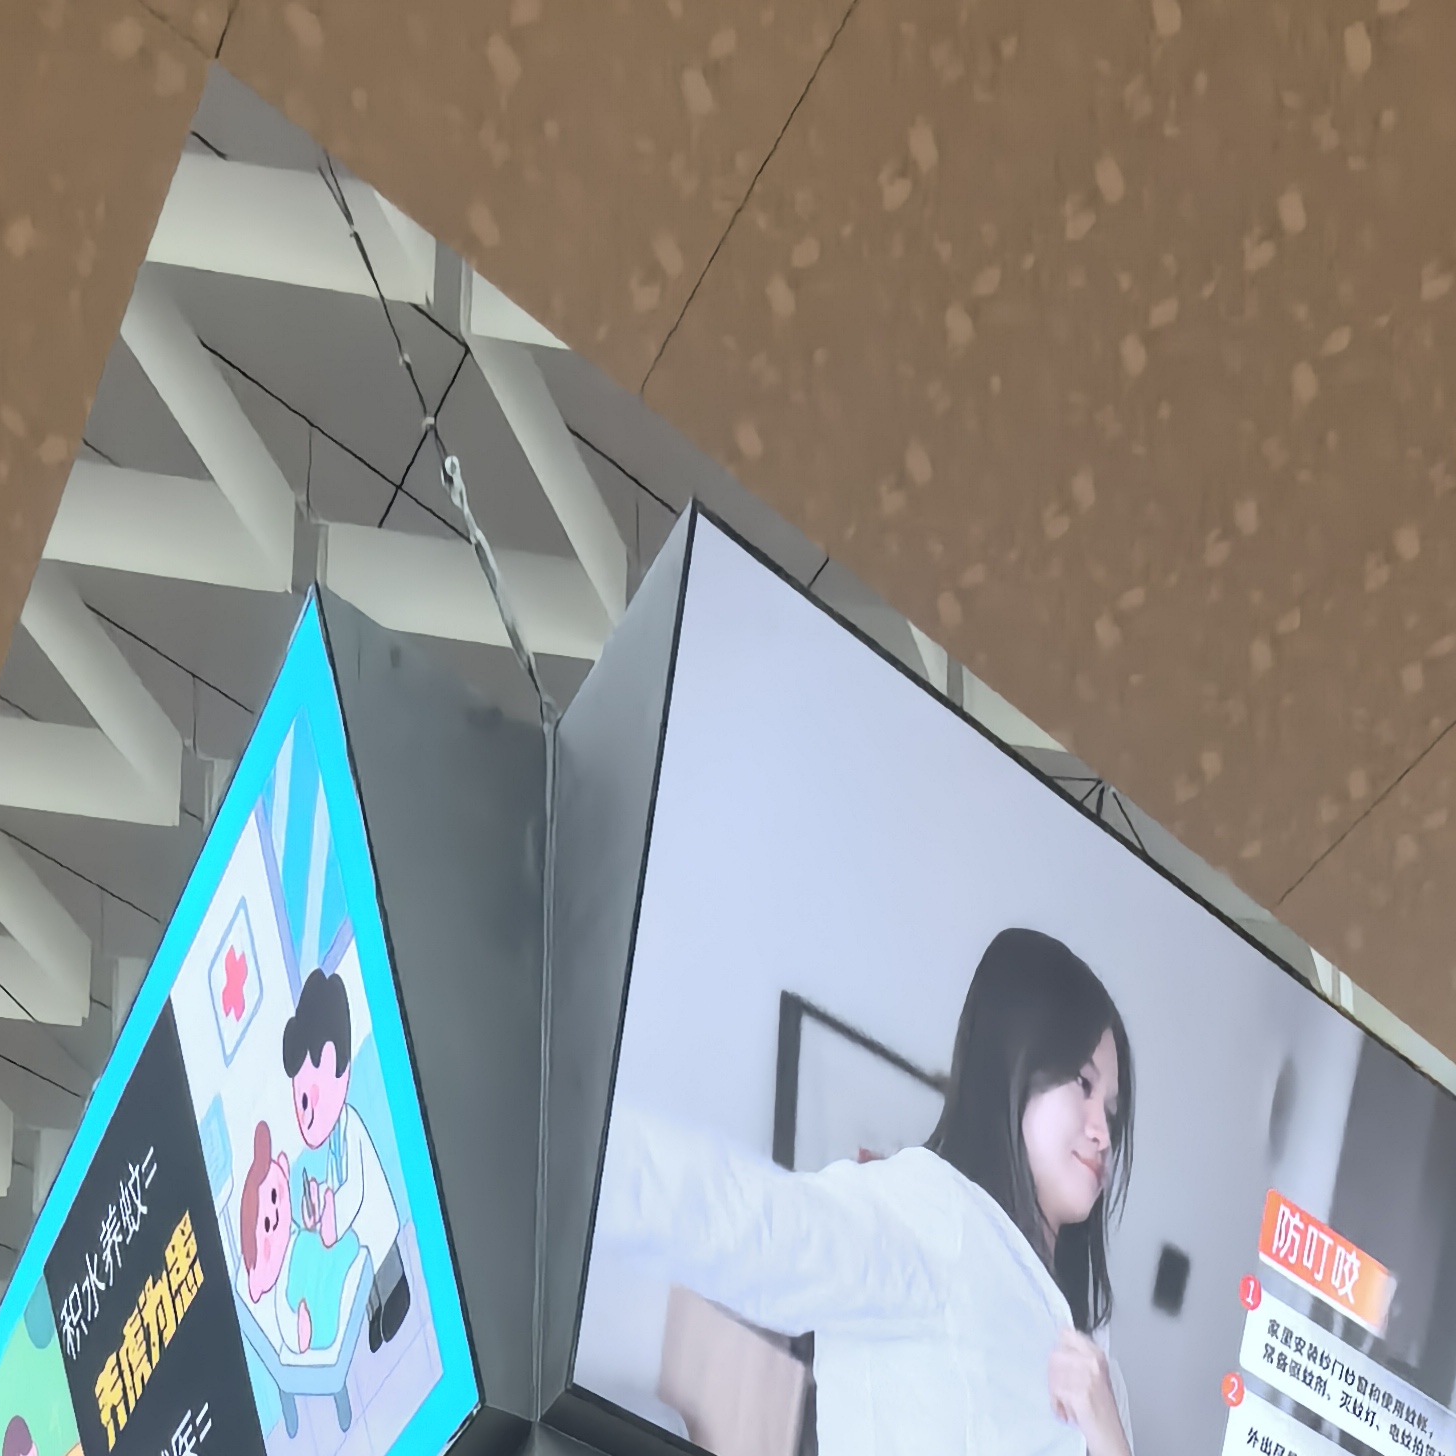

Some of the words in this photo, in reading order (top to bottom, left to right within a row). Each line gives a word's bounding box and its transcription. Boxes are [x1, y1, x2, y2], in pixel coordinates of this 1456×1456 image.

[1272, 1203, 1361, 1304] 防叮咬
[1245, 1280, 1255, 1305] 1
[95, 1209, 204, 1452] 养虎为患
[1228, 1376, 1239, 1402] 2
